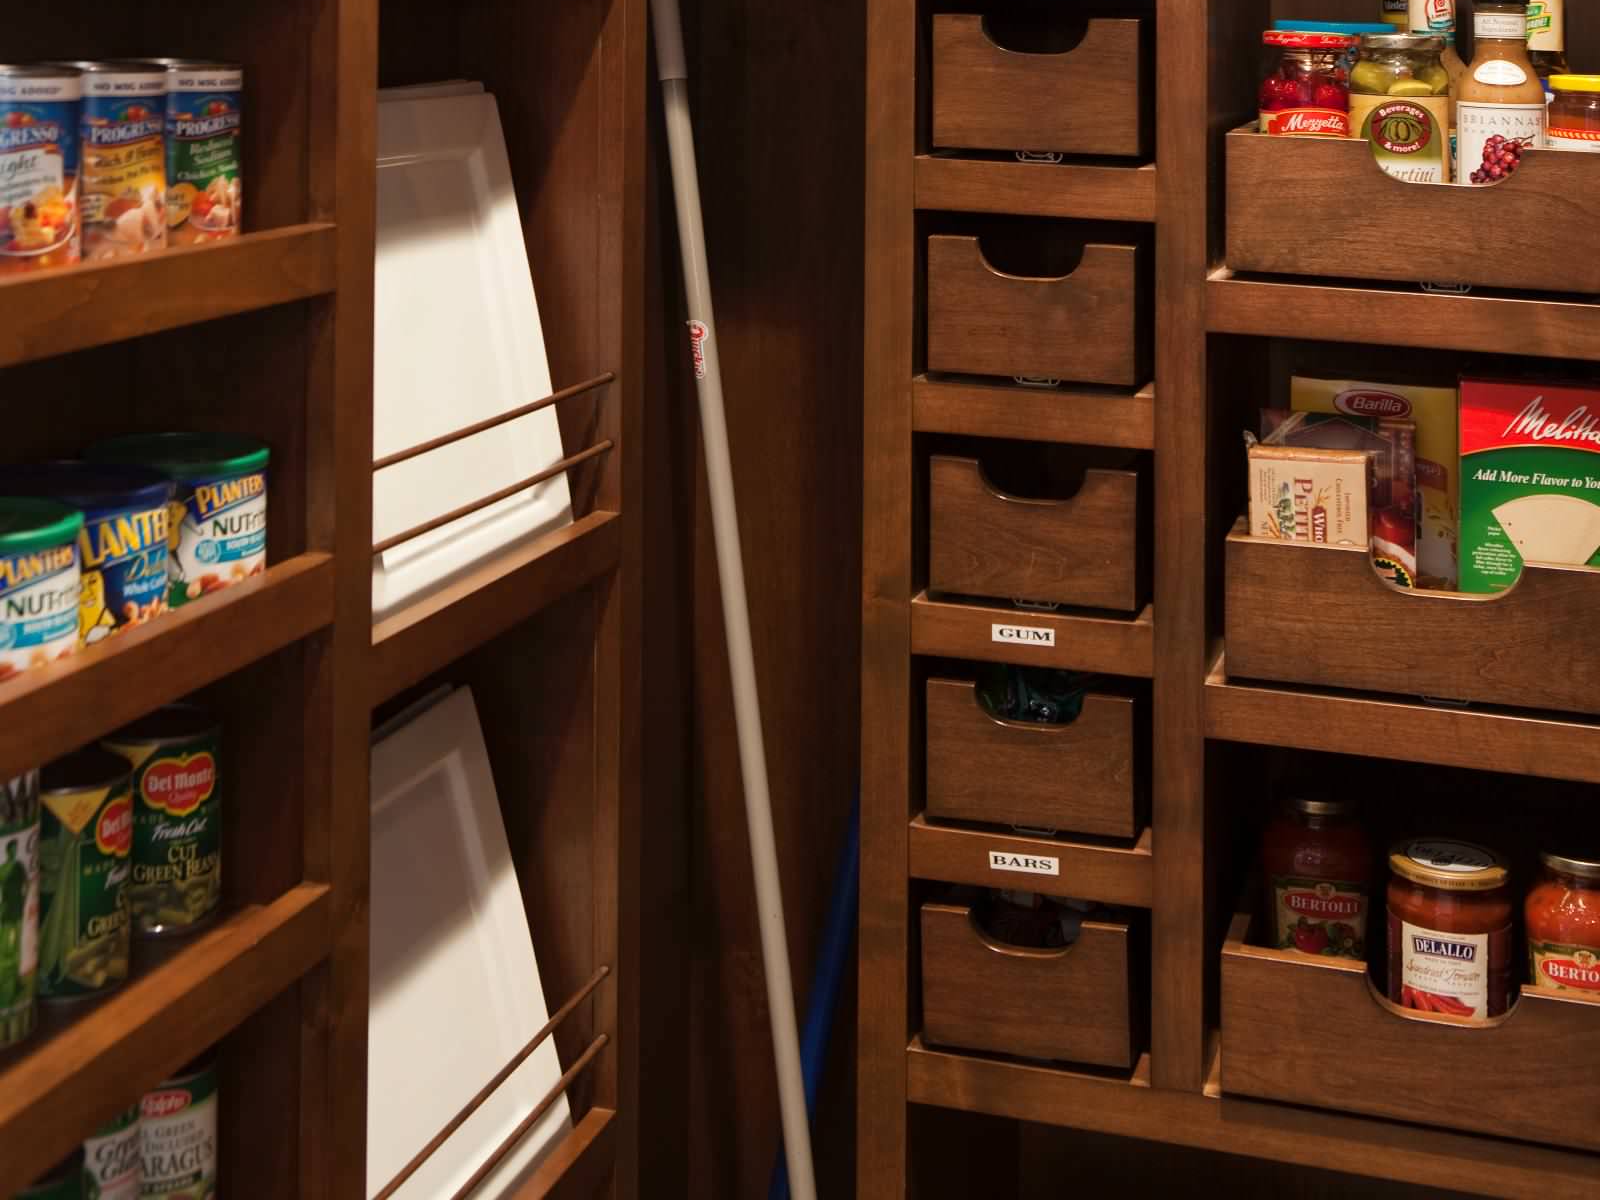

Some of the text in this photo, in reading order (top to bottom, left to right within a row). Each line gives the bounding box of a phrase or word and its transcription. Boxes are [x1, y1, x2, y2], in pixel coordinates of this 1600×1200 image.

[1378, 105, 1425, 119] Beverages
[1281, 114, 1344, 131] Mezzetta
[1384, 141, 1421, 152] & more!
[1353, 397, 1402, 412] Barilla
[1473, 469, 1497, 481] Add
[1500, 471, 1529, 484] More
[1532, 473, 1569, 488] Flavor
[1571, 477, 1582, 488] to
[999, 628, 1051, 642] GUM
[148, 768, 214, 793] Del Monte
[168, 844, 199, 863] CUT
[993, 855, 1052, 870] BARS
[133, 864, 183, 882] GREEN
[1291, 895, 1358, 913] BERTOLLI
[1416, 938, 1473, 959] DELALLO
